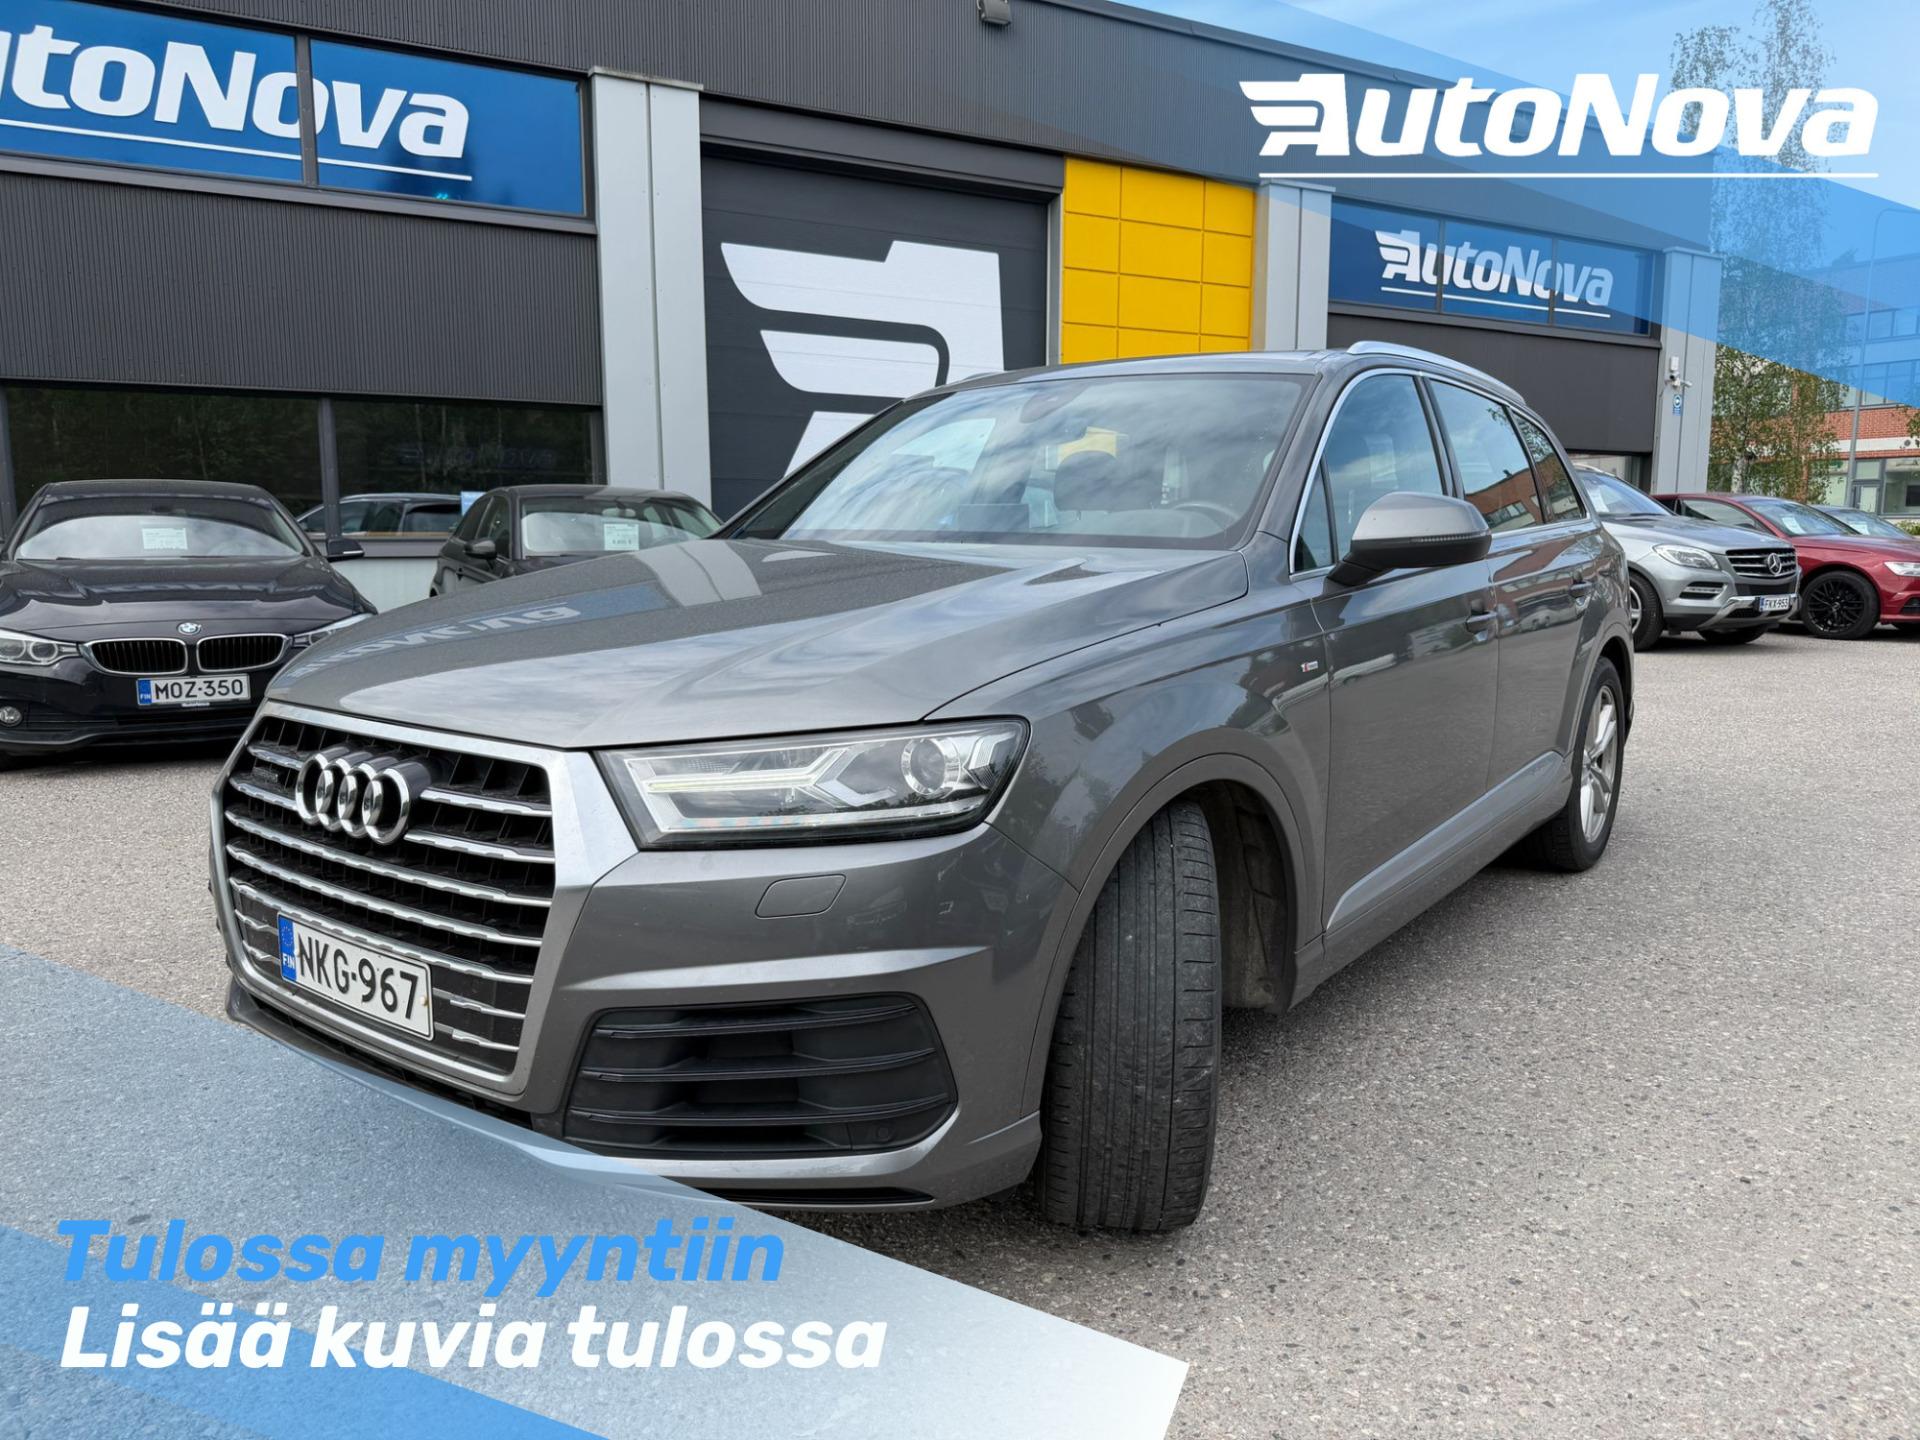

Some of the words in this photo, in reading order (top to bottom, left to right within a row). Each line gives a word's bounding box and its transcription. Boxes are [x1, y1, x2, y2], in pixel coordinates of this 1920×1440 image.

[0, 25, 469, 158] toNova
[1375, 229, 1614, 306] AutoNova
[155, 679, 243, 700] MOZ-350
[282, 952, 296, 970] FIN
[298, 932, 419, 1020] NKG-967
